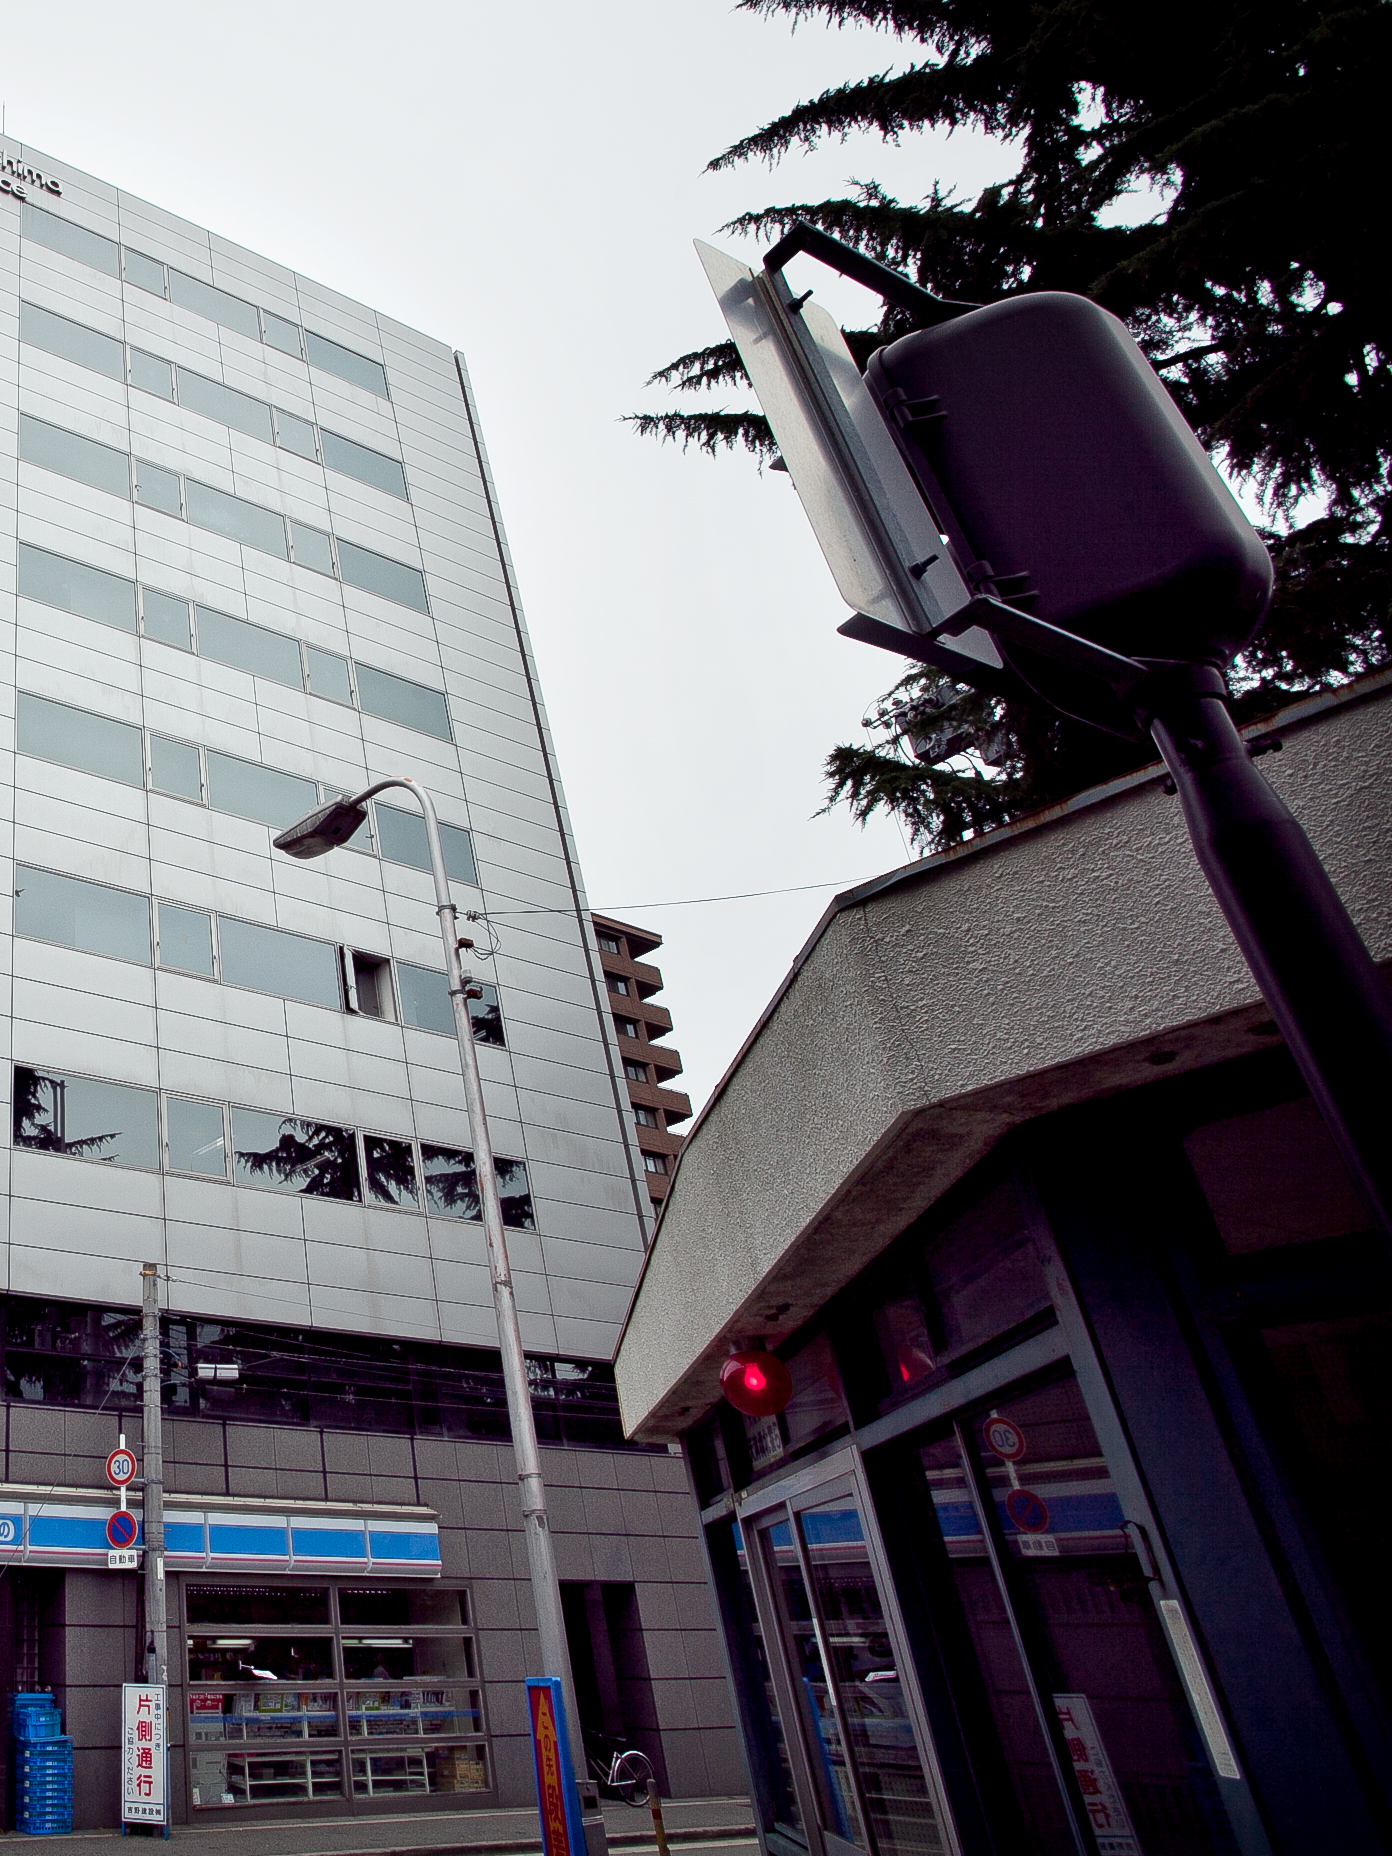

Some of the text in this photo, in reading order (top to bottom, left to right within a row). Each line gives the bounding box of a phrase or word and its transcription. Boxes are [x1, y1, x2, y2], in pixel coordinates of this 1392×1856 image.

[113, 1459, 130, 1476] 30
[109, 1554, 135, 1564] 自動車
[136, 1693, 153, 1797] 片側通行
[154, 1693, 162, 1750] 工事中につき
[126, 1727, 135, 1795] ご協力ください
